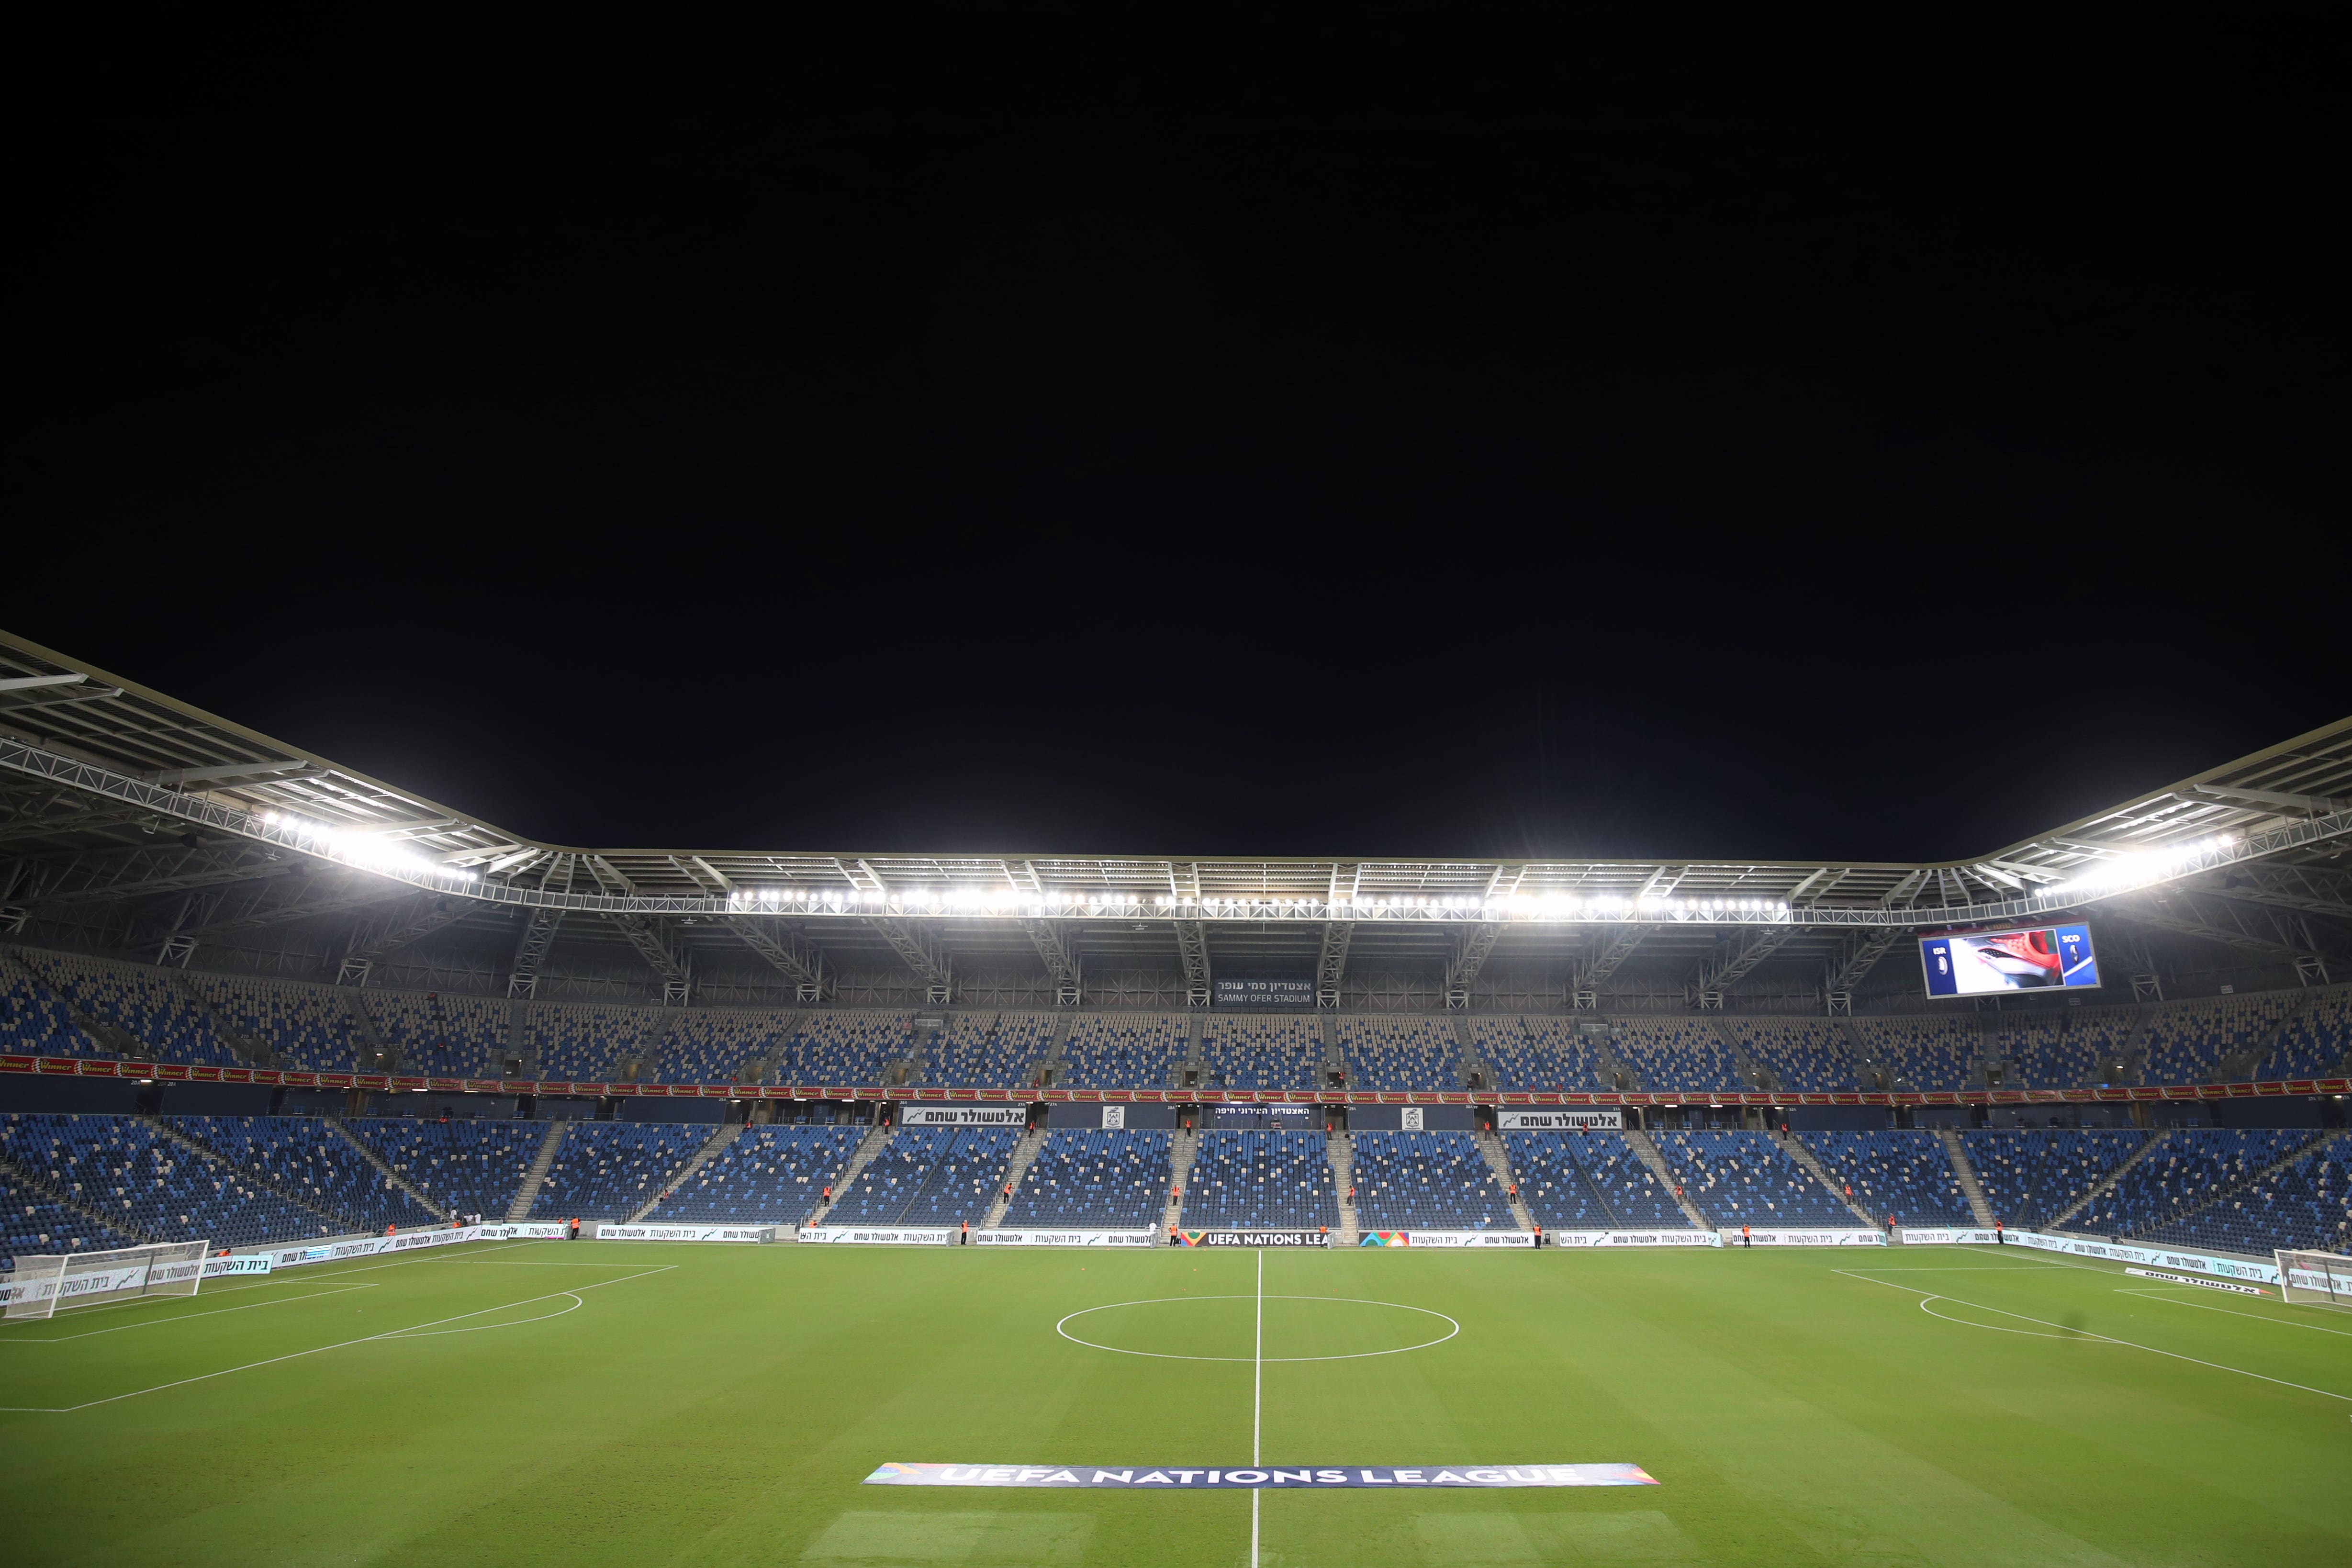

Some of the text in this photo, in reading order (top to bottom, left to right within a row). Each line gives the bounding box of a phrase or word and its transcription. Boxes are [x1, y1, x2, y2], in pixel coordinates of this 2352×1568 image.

[2061, 934, 2081, 943] SCO
[1218, 982, 1311, 992] אצטדיון סמי עופר
[1218, 994, 1310, 1003] SAMMY OFER STADIUM
[925, 1109, 1024, 1122] אלטשולר שחם
[1271, 1108, 1310, 1116] האצטדיון
[1520, 1113, 1617, 1126] אלטשולר שחם
[431, 1231, 463, 1243] בית השקעות
[481, 1229, 497, 1237] שחם
[601, 1228, 646, 1237] אלטשולר שחם
[650, 1229, 696, 1239] בית השקעות
[723, 1231, 738, 1239] שחם
[814, 1232, 827, 1240] בית
[871, 1232, 899, 1241] אלטשולר
[903, 1232, 934, 1243] השקעות
[977, 1233, 1023, 1242] אלטשולר שחם
[395, 1234, 431, 1248] אלטשולר שחם
[1035, 1235, 1066, 1244] השקעות
[1208, 1234, 1241, 1245] UEFA
[1244, 1233, 1302, 1245] NATIONS
[1412, 1236, 1443, 1246] השקעות
[1501, 1235, 1529, 1244] אלטשולר
[1574, 1236, 1587, 1244] בית
[1613, 1235, 1657, 1243] אלטשולר שחם
[1661, 1235, 1706, 1244] בית השקעות
[1788, 1234, 1833, 1244] בית השקעות
[1905, 1233, 1950, 1243] בית השקעות
[362, 1243, 374, 1252] בית
[2048, 1239, 2058, 1249] בית
[334, 1244, 362, 1256] השקעות
[2109, 1248, 2146, 1261] בית השקעות
[281, 1254, 296, 1263] שחם
[2166, 1255, 2207, 1270] אלטשולר שחם
[204, 1260, 269, 1275] בית השקעות
[2217, 1263, 2263, 1278] בית השקעות
[90, 1276, 110, 1289] בית
[2145, 1271, 2256, 1293] אלטשולר שחם
[2290, 1273, 2308, 1285] שחם
[939, 1467, 1585, 1484] UEFA NATIONS LEAGUE
